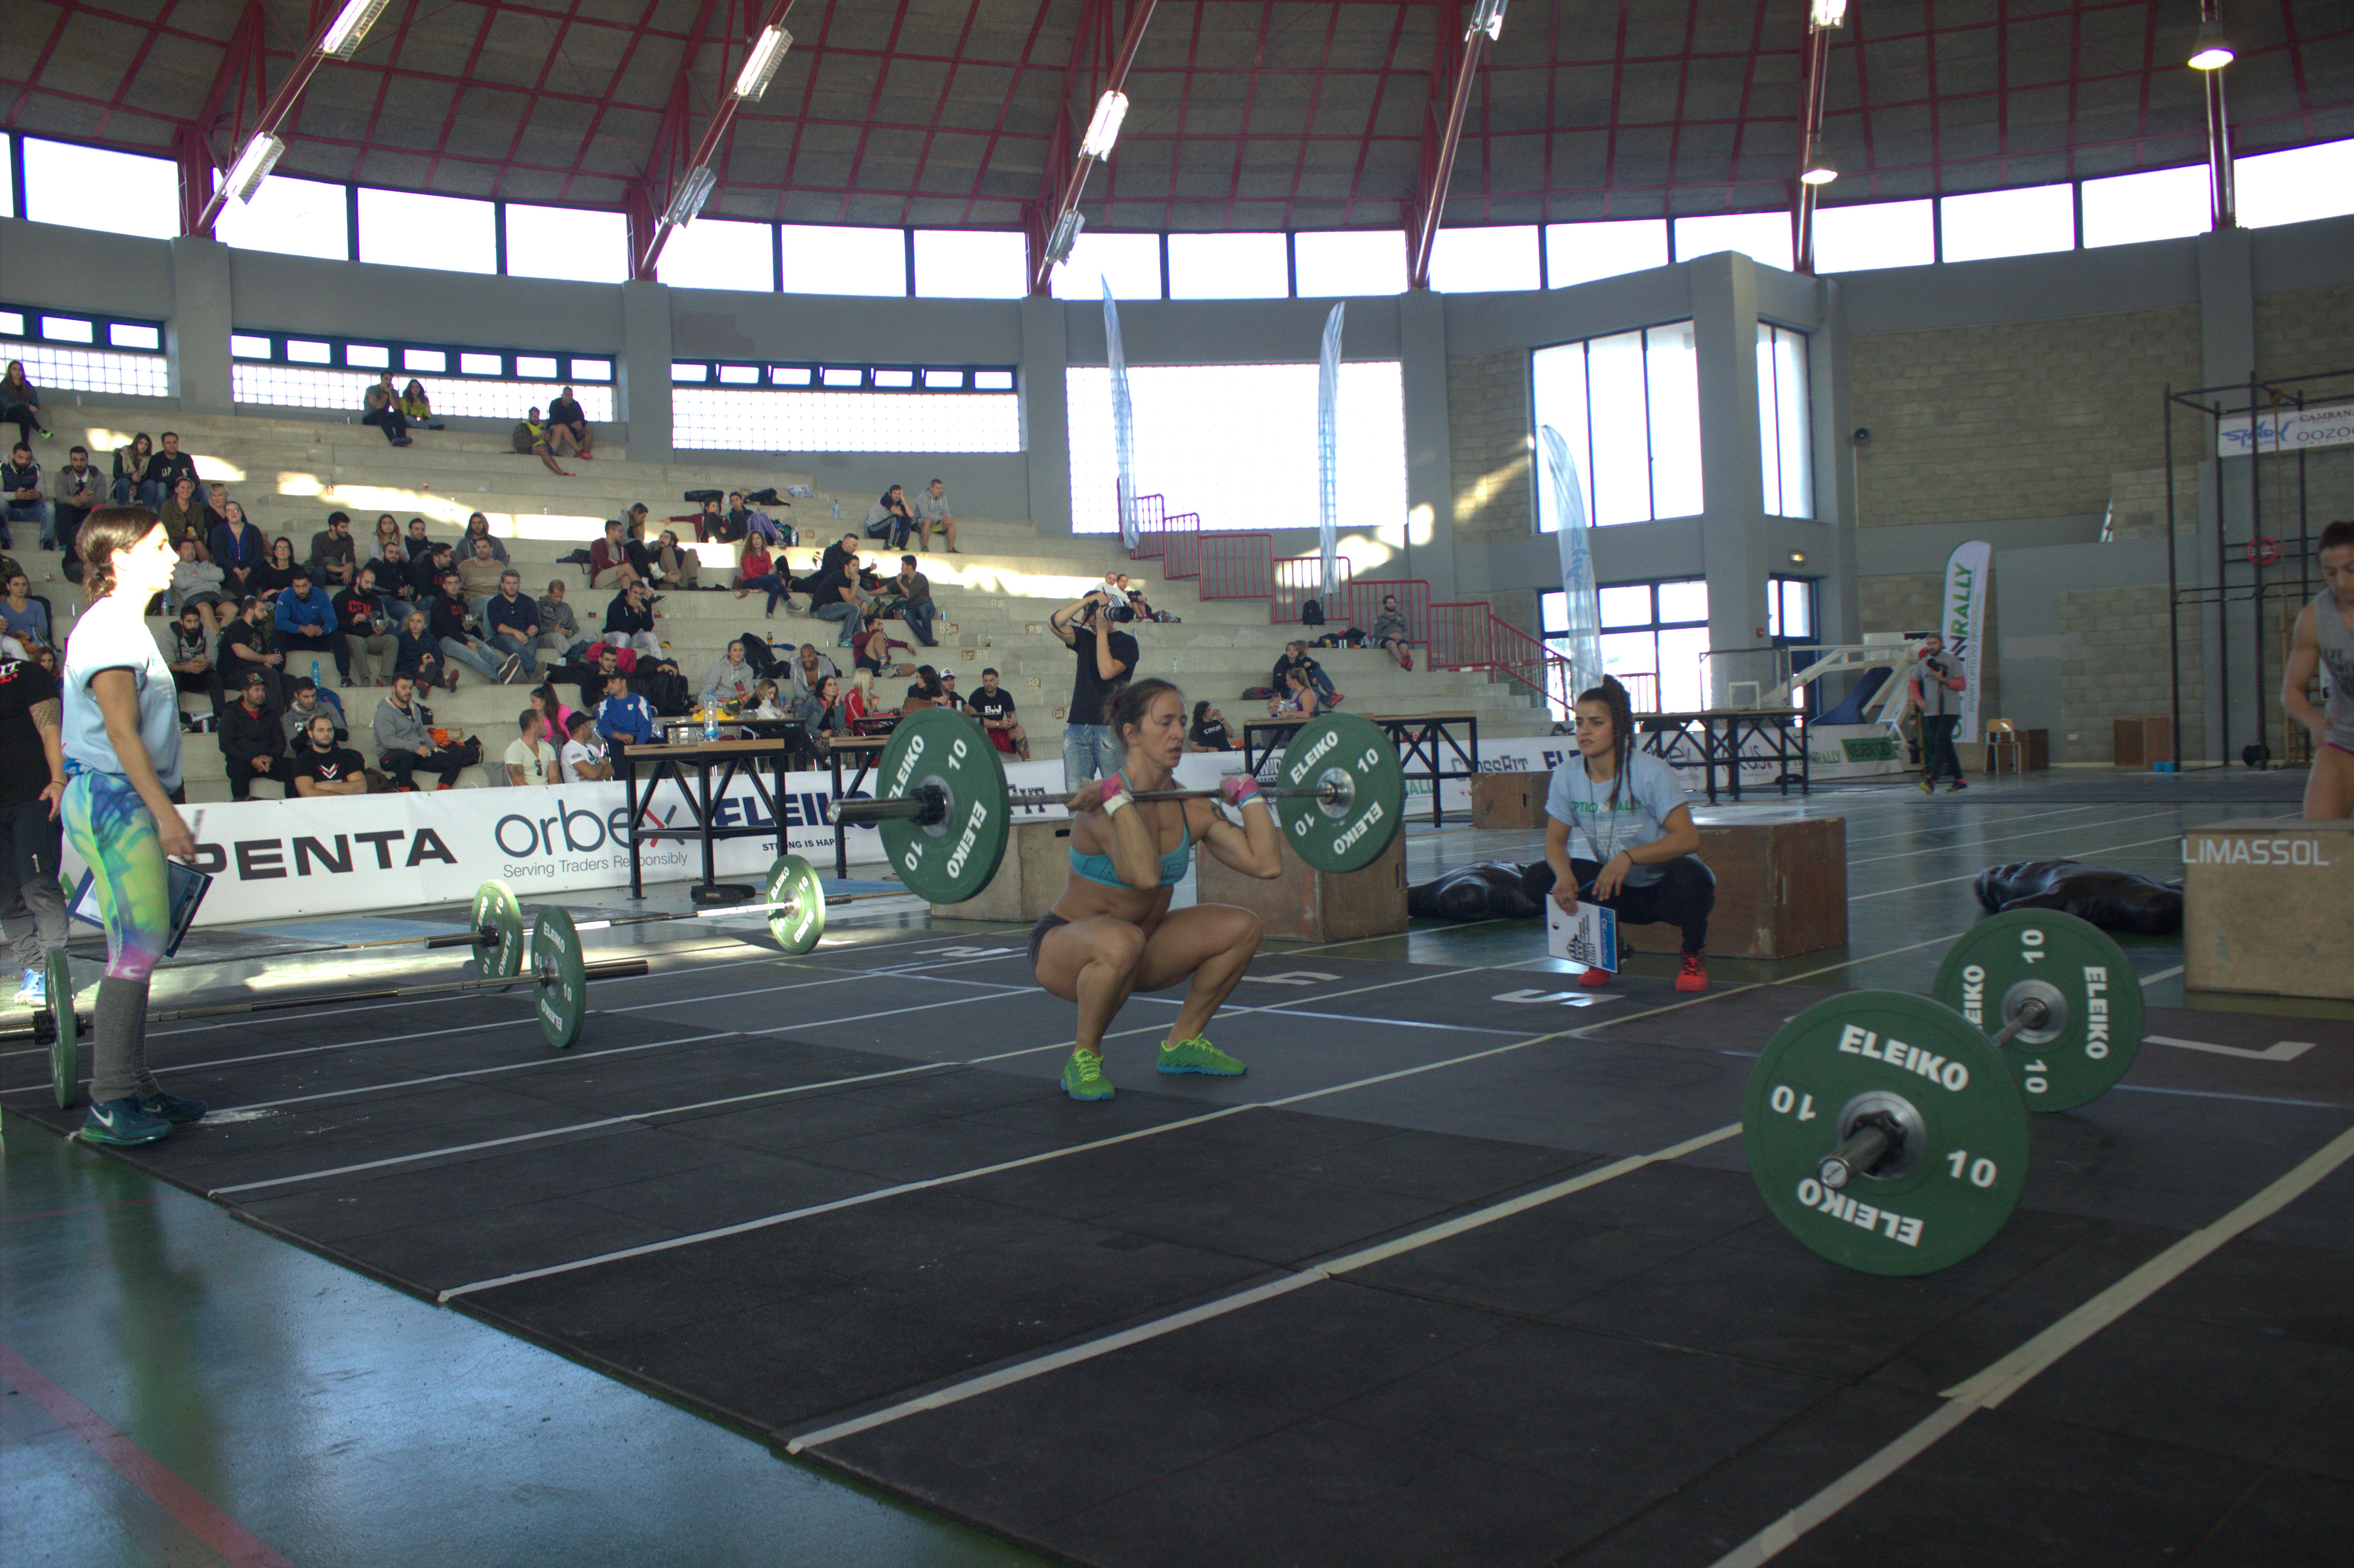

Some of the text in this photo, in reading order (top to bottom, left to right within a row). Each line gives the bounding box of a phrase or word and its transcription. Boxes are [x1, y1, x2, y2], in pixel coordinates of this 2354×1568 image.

[948, 739, 967, 770] 10
[1290, 730, 1338, 786] ELEIKO
[1358, 748, 1379, 773] 10
[495, 799, 686, 858] orbex
[947, 799, 987, 878] ELEIKO
[1295, 812, 1315, 836] 10
[1333, 800, 1384, 855] ELEIKO
[762, 841, 802, 851] STNG
[816, 838, 846, 847] HAP
[905, 841, 923, 871] 10
[2182, 839, 2330, 866] LIMASSOL
[503, 852, 687, 877] Serving Traders Reponsibly
[770, 866, 790, 901] ELEIKO
[799, 876, 809, 892] 10
[499, 930, 512, 976] ELEIKO
[543, 921, 565, 953] ELEIKO
[2020, 929, 2045, 964] 10
[563, 983, 572, 1002] 10
[1963, 964, 1986, 1029] EIKO
[541, 998, 562, 1032] ELEIKO
[2083, 966, 2109, 1059] ELEIKO
[1838, 1024, 1969, 1091] ELEIKO
[2024, 1058, 2048, 1093] 10
[1770, 1085, 1816, 1122] 10
[1946, 1149, 1997, 1188] 10
[1796, 1178, 1925, 1247] ELEIKO
